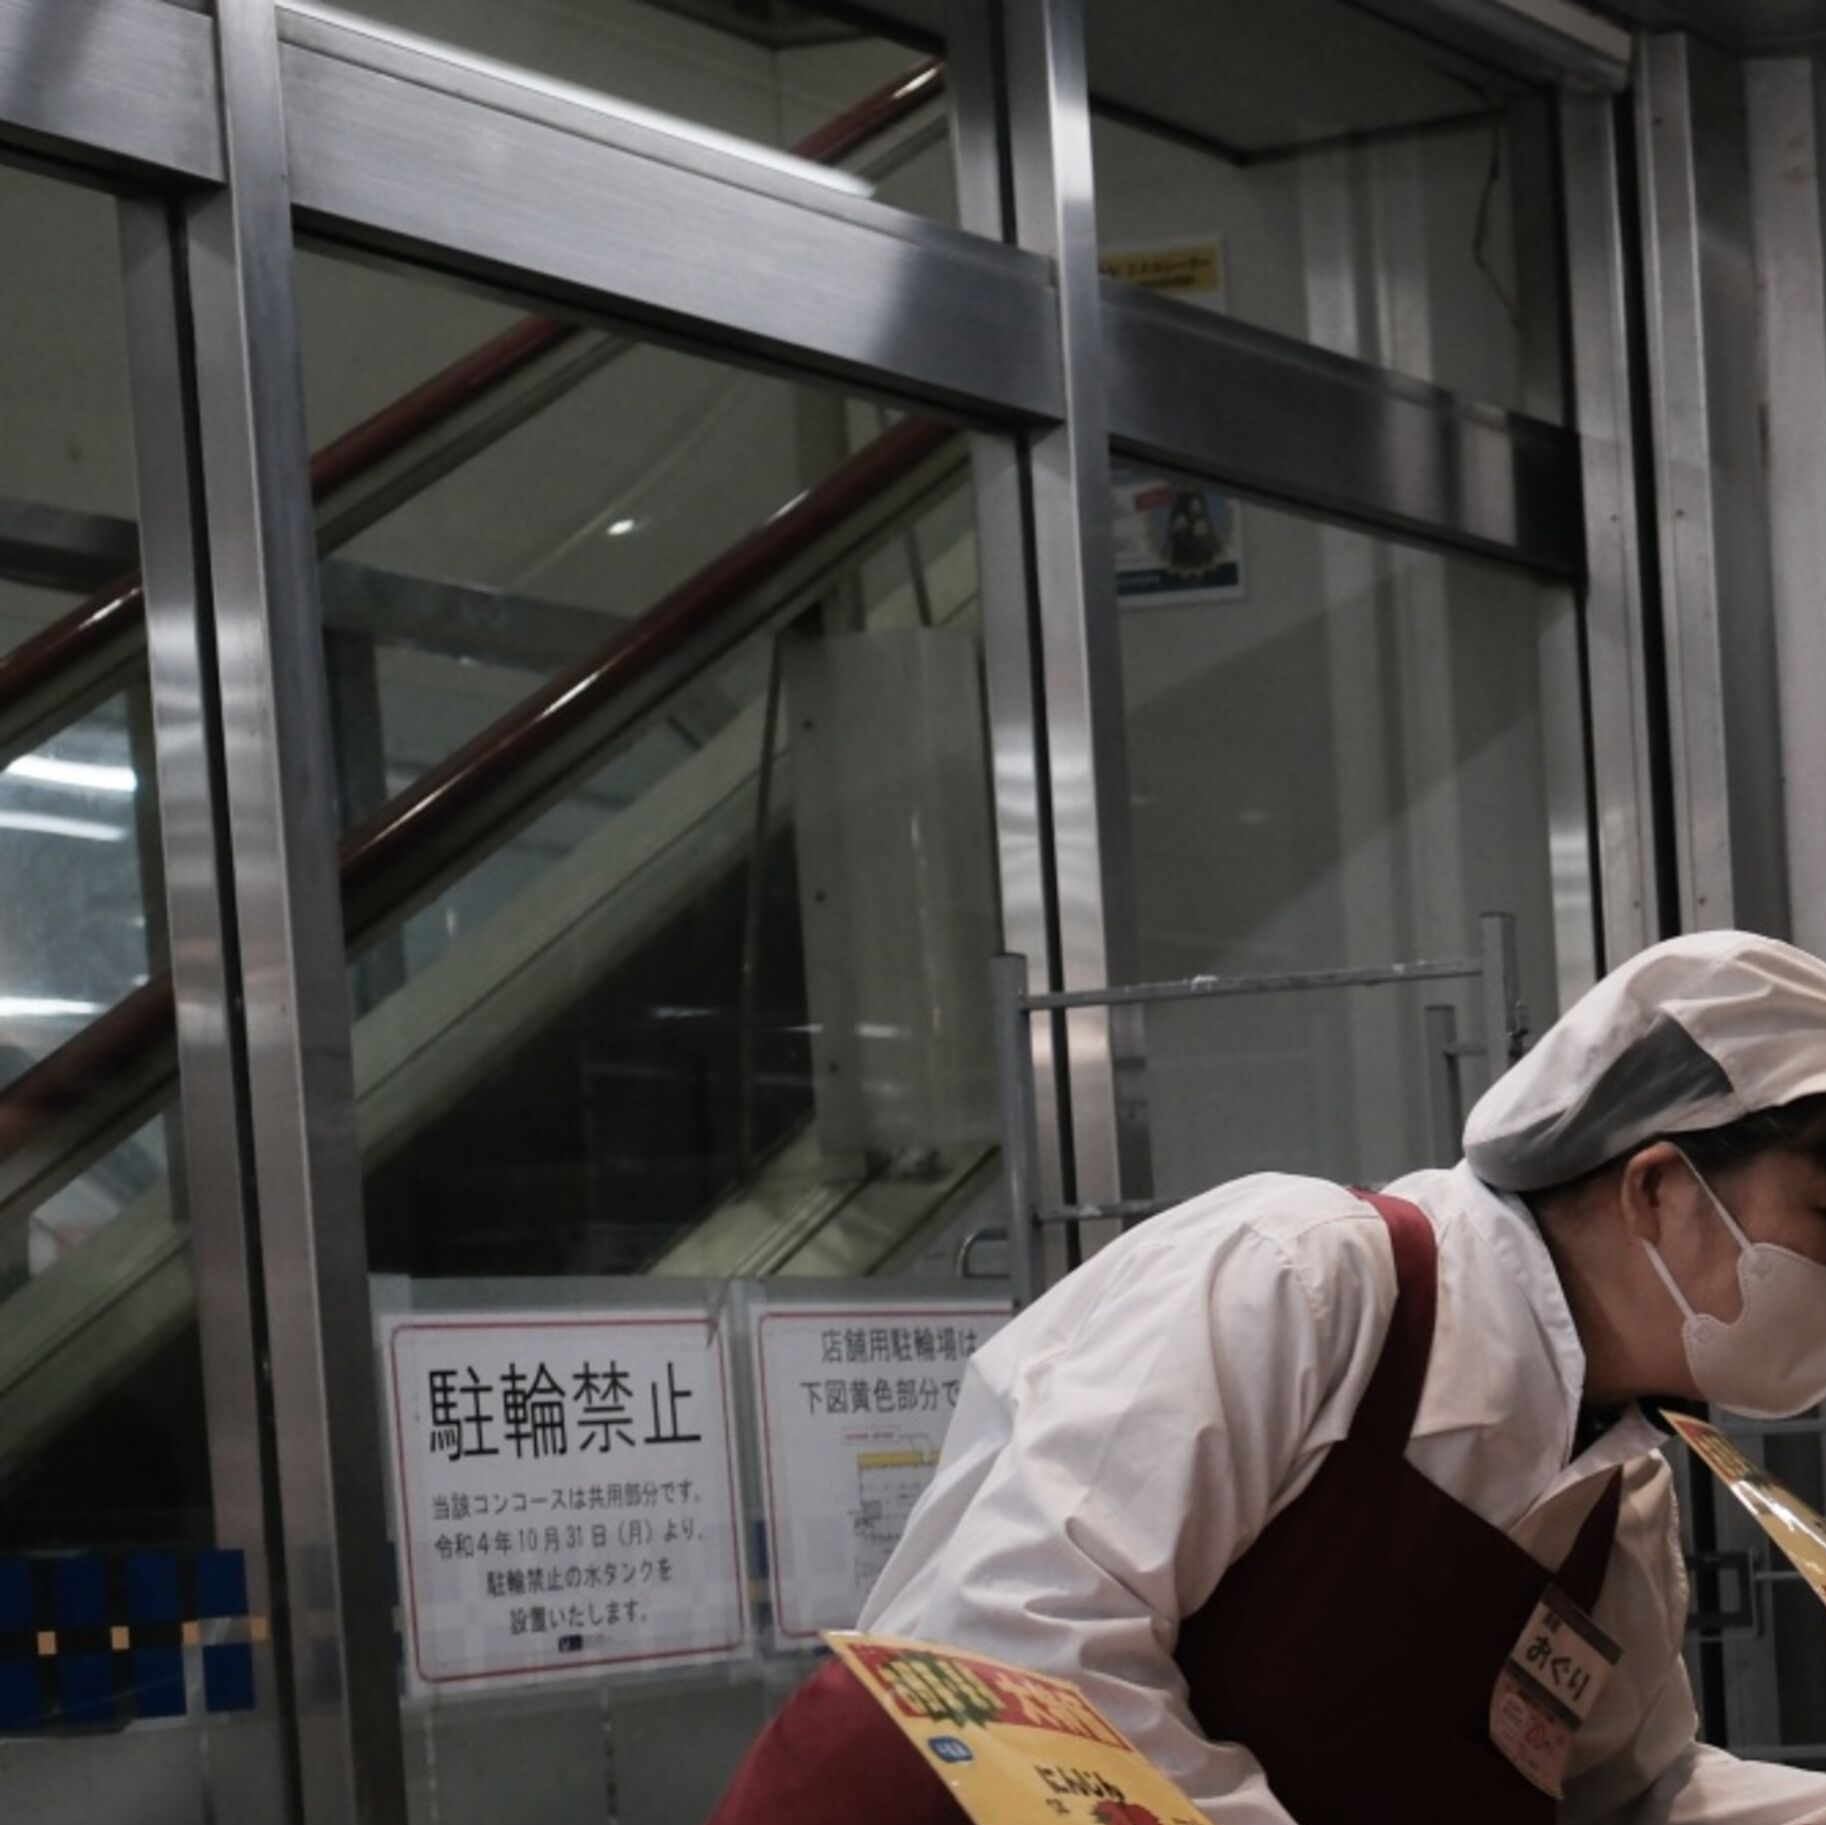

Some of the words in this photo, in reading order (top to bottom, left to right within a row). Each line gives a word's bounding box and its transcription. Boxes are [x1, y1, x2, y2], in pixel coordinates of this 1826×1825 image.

[820, 1326, 978, 1364] 店舗用駐輪場は
[428, 1361, 702, 1461] 駐輪禁止
[431, 1480, 701, 1521] 当該コンコースは共用部分です。
[486, 1557, 673, 1598] 駐輪禁止の水タンクを
[509, 1600, 648, 1636] 設置いたします。
[1526, 1635, 1591, 1701] おぐり
